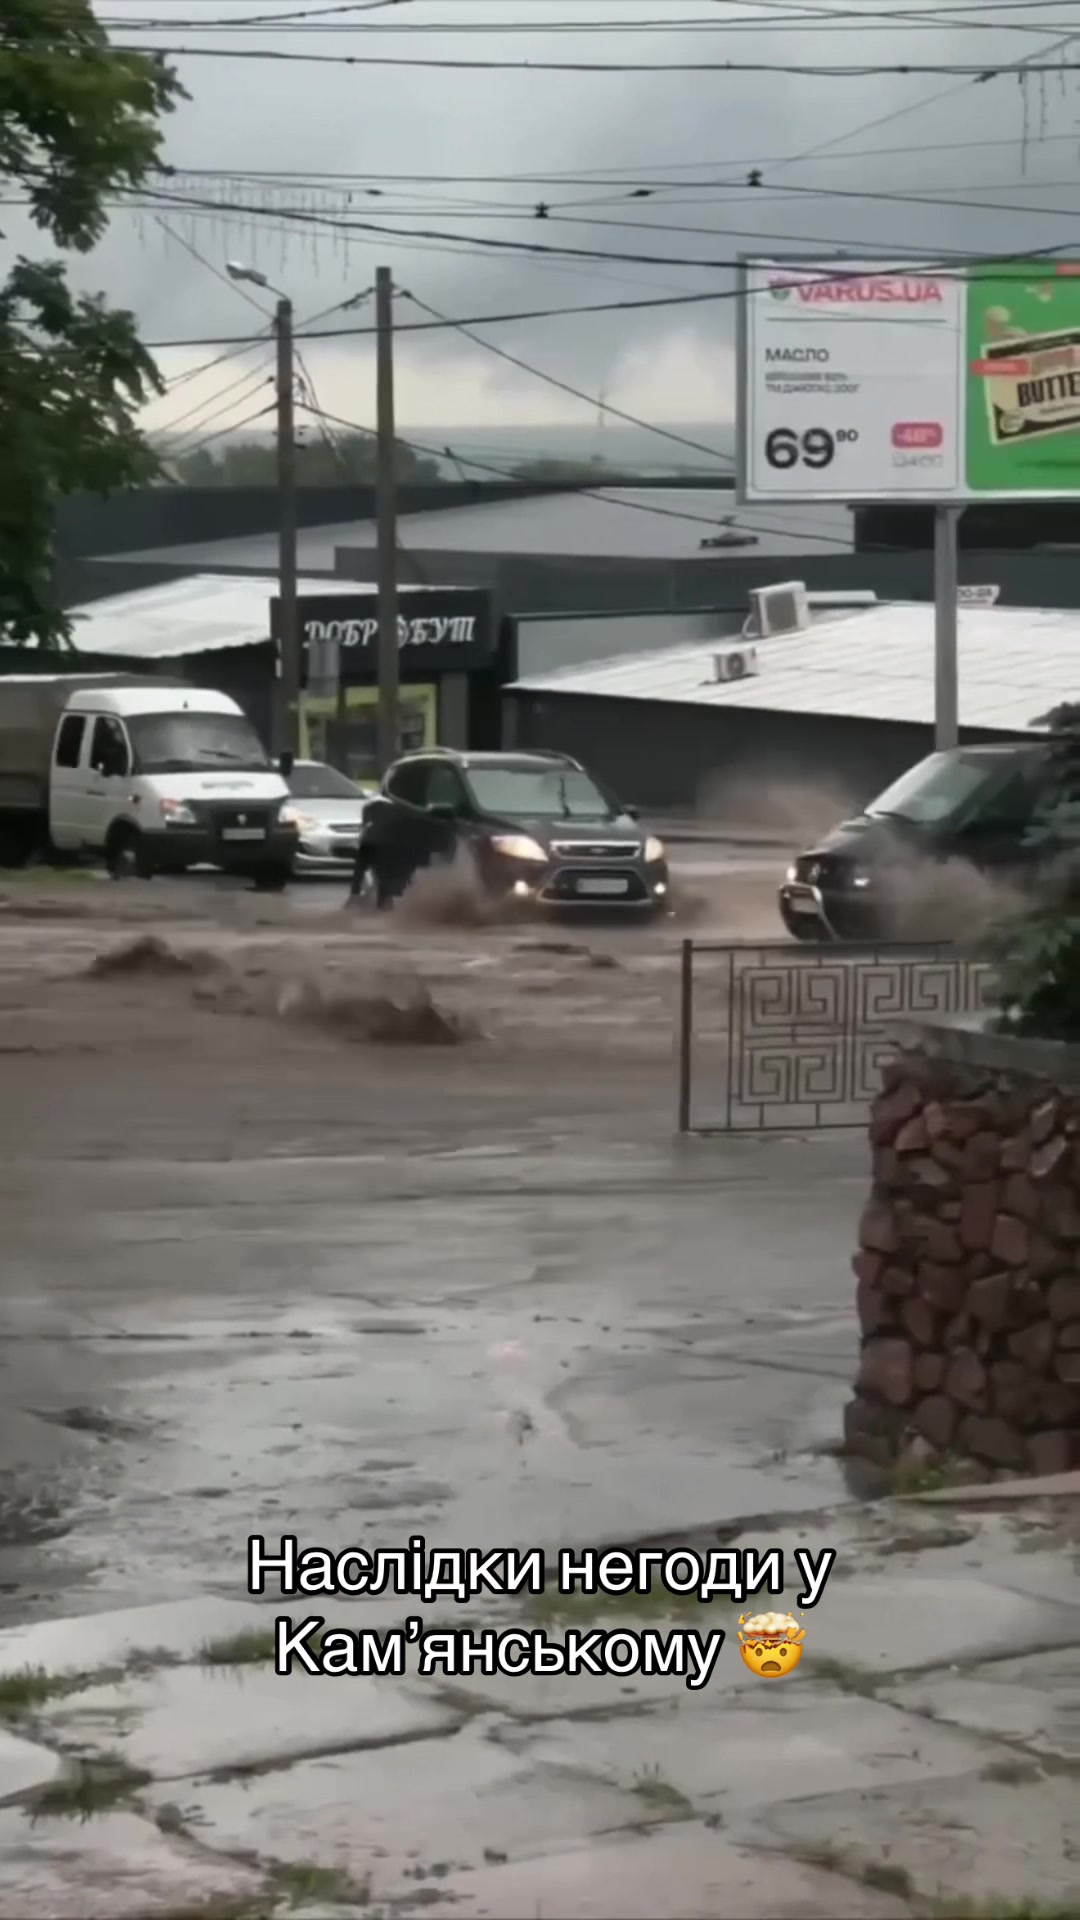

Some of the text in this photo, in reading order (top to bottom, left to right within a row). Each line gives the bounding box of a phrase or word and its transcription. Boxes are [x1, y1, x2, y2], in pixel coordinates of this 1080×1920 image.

[797, 278, 943, 302] VARUS.UA
[765, 347, 830, 363] МАСЛО
[764, 427, 859, 469] 69 90
